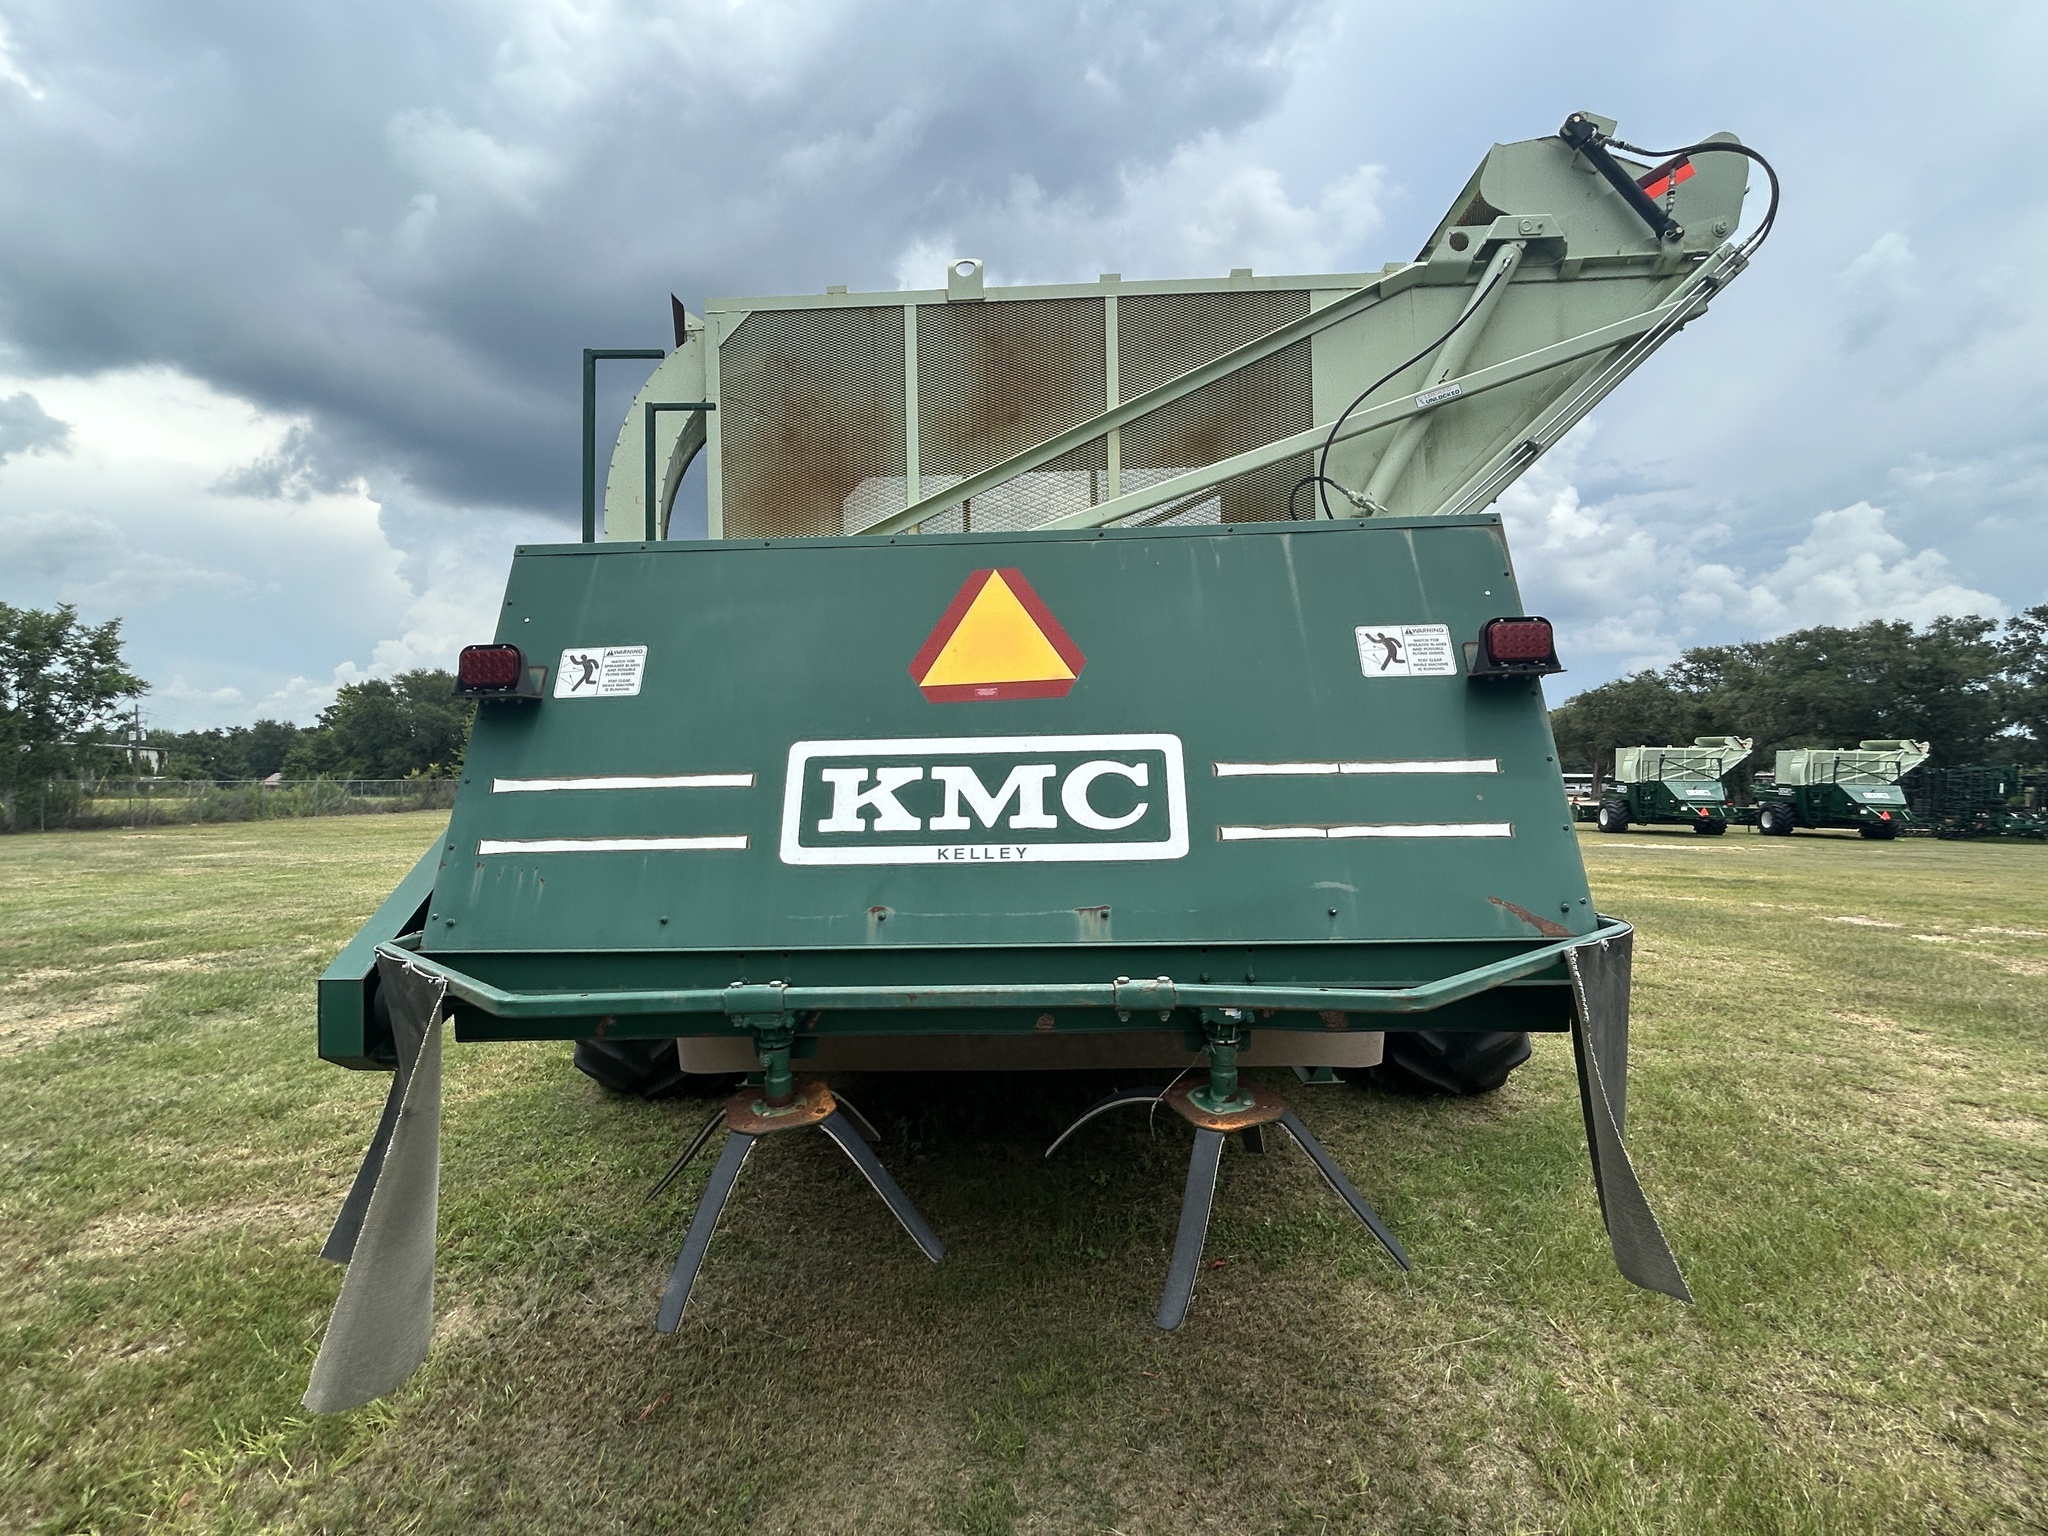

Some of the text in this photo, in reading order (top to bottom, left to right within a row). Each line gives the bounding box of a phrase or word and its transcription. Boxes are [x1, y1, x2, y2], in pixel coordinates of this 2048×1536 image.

[1425, 390, 1460, 404] UNLOCKED
[818, 760, 1149, 833] KMC
[937, 847, 1028, 861] KELLEY
